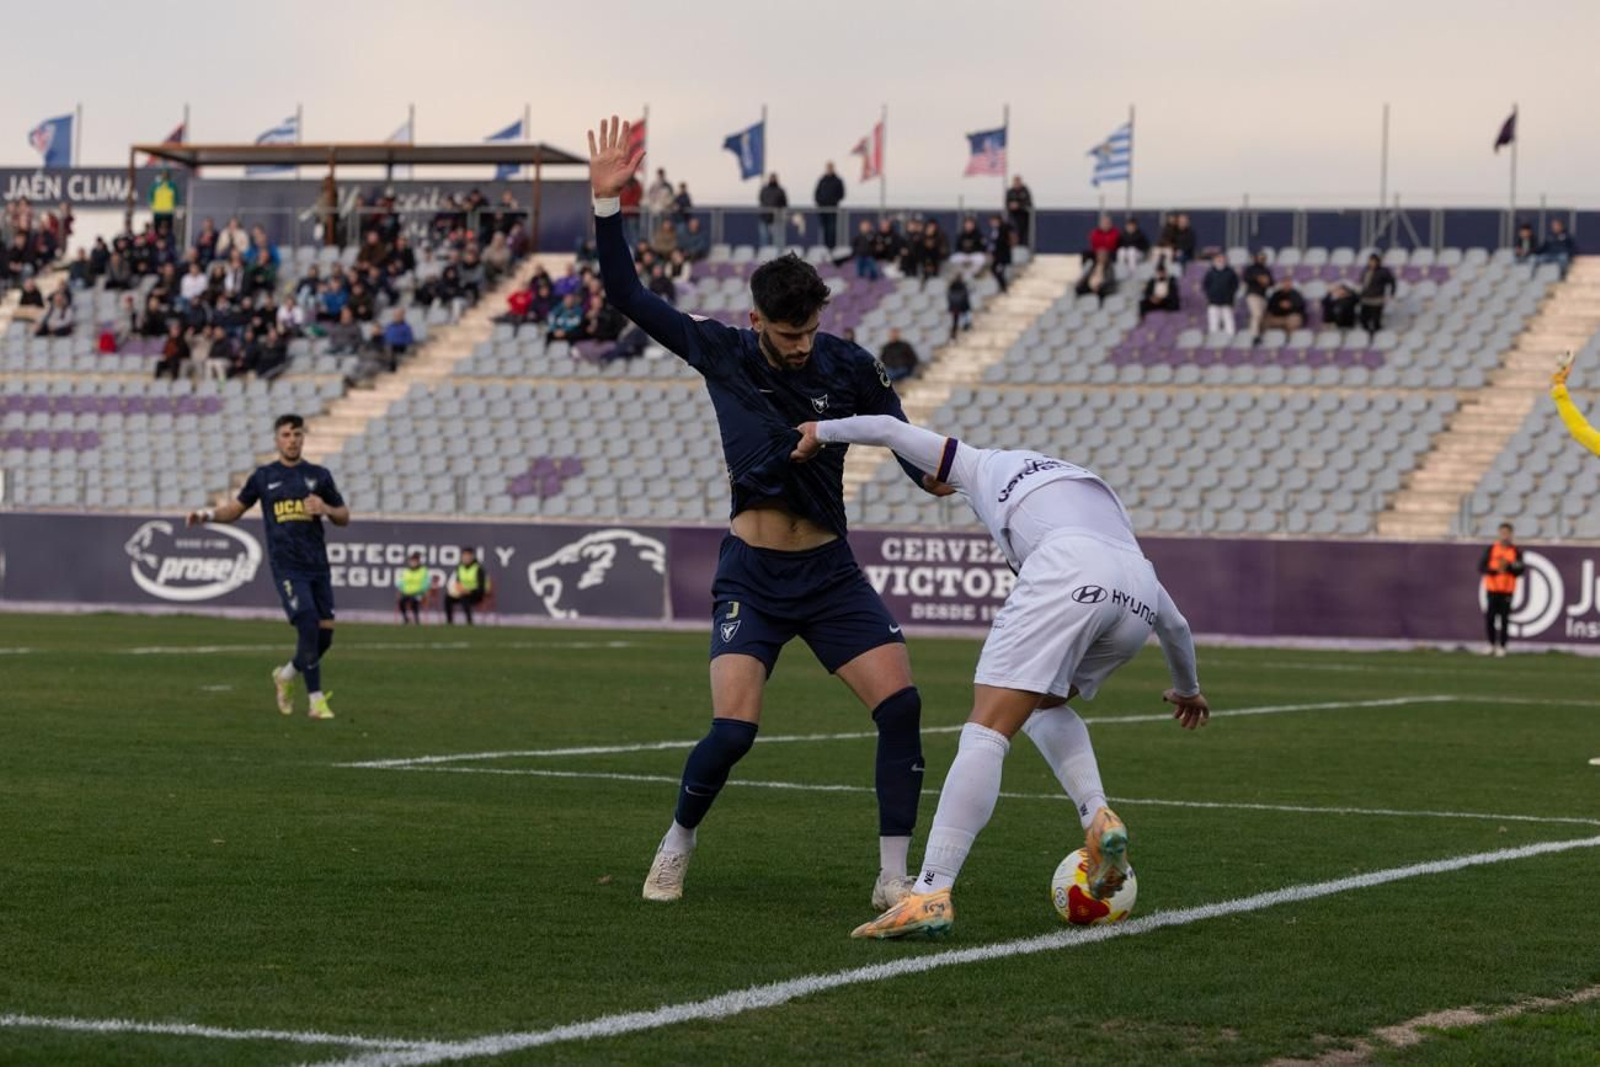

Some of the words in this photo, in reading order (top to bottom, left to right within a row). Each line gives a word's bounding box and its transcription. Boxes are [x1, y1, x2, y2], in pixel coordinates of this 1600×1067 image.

[3, 170, 62, 200] JAÉN
[273, 500, 305, 516] UCA
[496, 546, 515, 567] Y
[881, 537, 1007, 564] CERVEZ
[864, 565, 1019, 599] VICTOR
